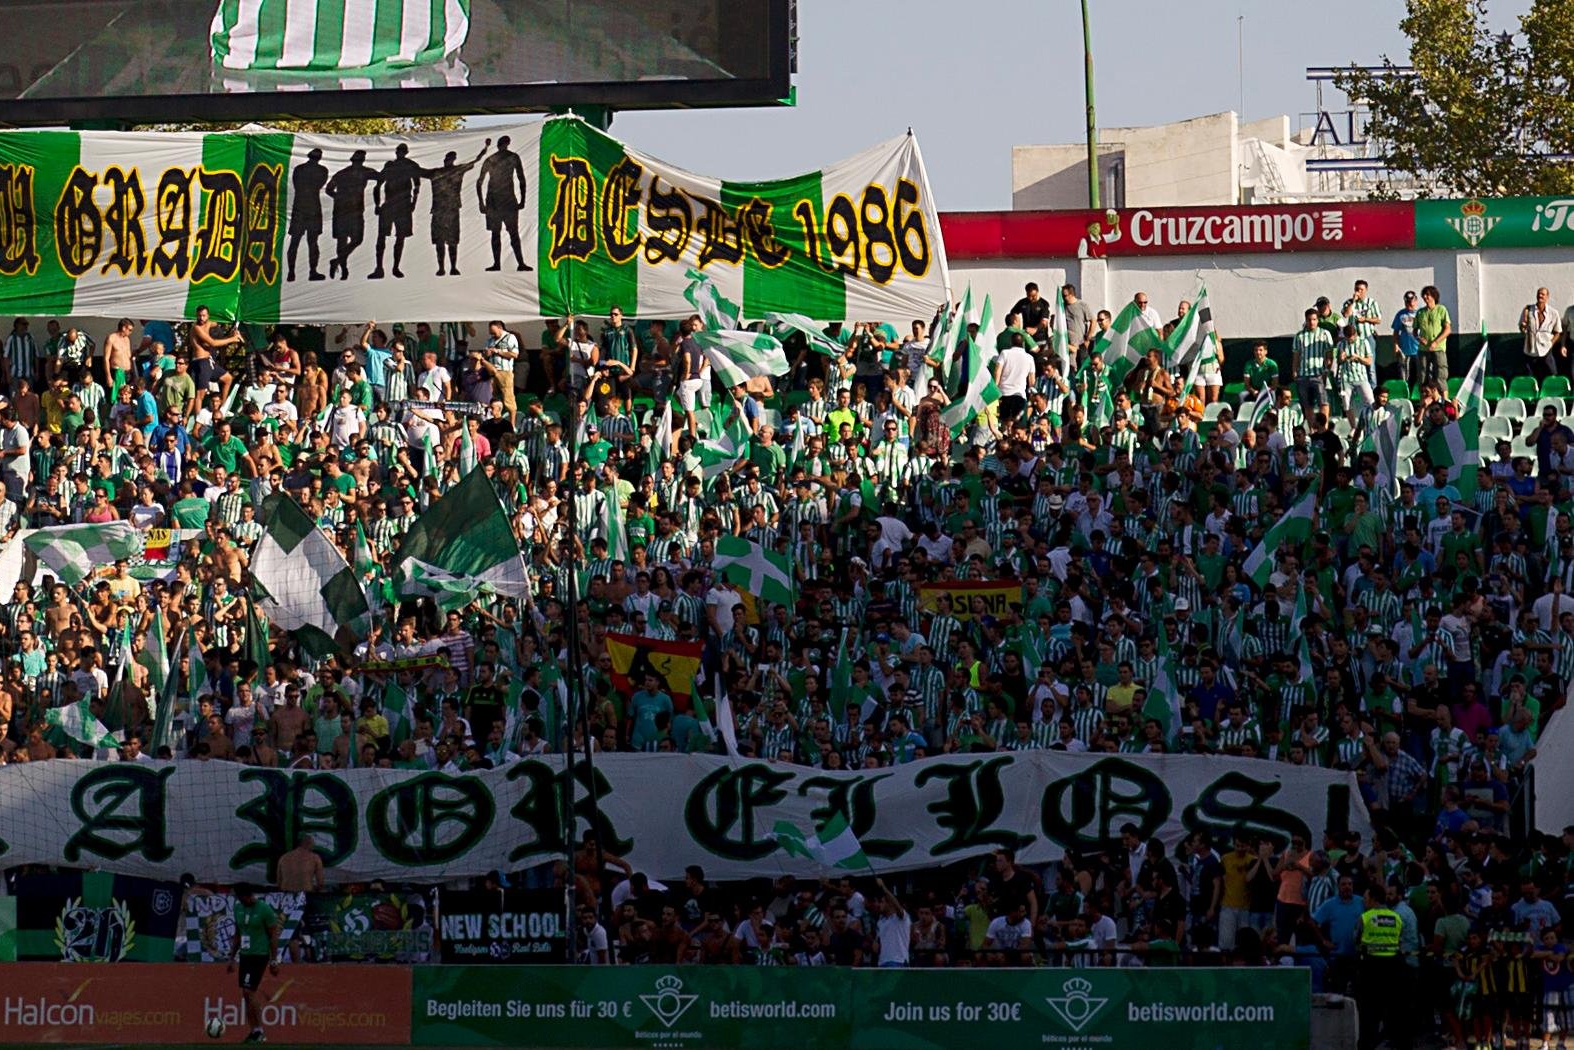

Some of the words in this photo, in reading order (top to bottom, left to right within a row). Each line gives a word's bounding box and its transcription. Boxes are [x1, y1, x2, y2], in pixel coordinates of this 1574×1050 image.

[55, 163, 285, 286] GRADA
[548, 153, 793, 270] DESDE
[796, 176, 932, 286] 1986
[1130, 210, 1316, 250] Cruzcampo
[1323, 211, 1342, 240] SIN
[64, 764, 175, 862] A
[228, 760, 634, 884] POR
[440, 913, 483, 940] NEW
[486, 911, 567, 939] SCHOOL
[427, 999, 502, 1022] Begleiten
[506, 999, 531, 1019] Sie
[535, 1004, 566, 1019] uns
[570, 999, 594, 1019] für
[597, 1000, 619, 1019] 30
[622, 1000, 633, 1019] €
[709, 999, 837, 1020] betisworld.com
[884, 1001, 924, 1022] Join
[928, 1006, 951, 1022] us
[956, 1001, 982, 1021] for
[987, 1001, 1022, 1022] 30€
[1128, 1001, 1275, 1023] betisworld.com
